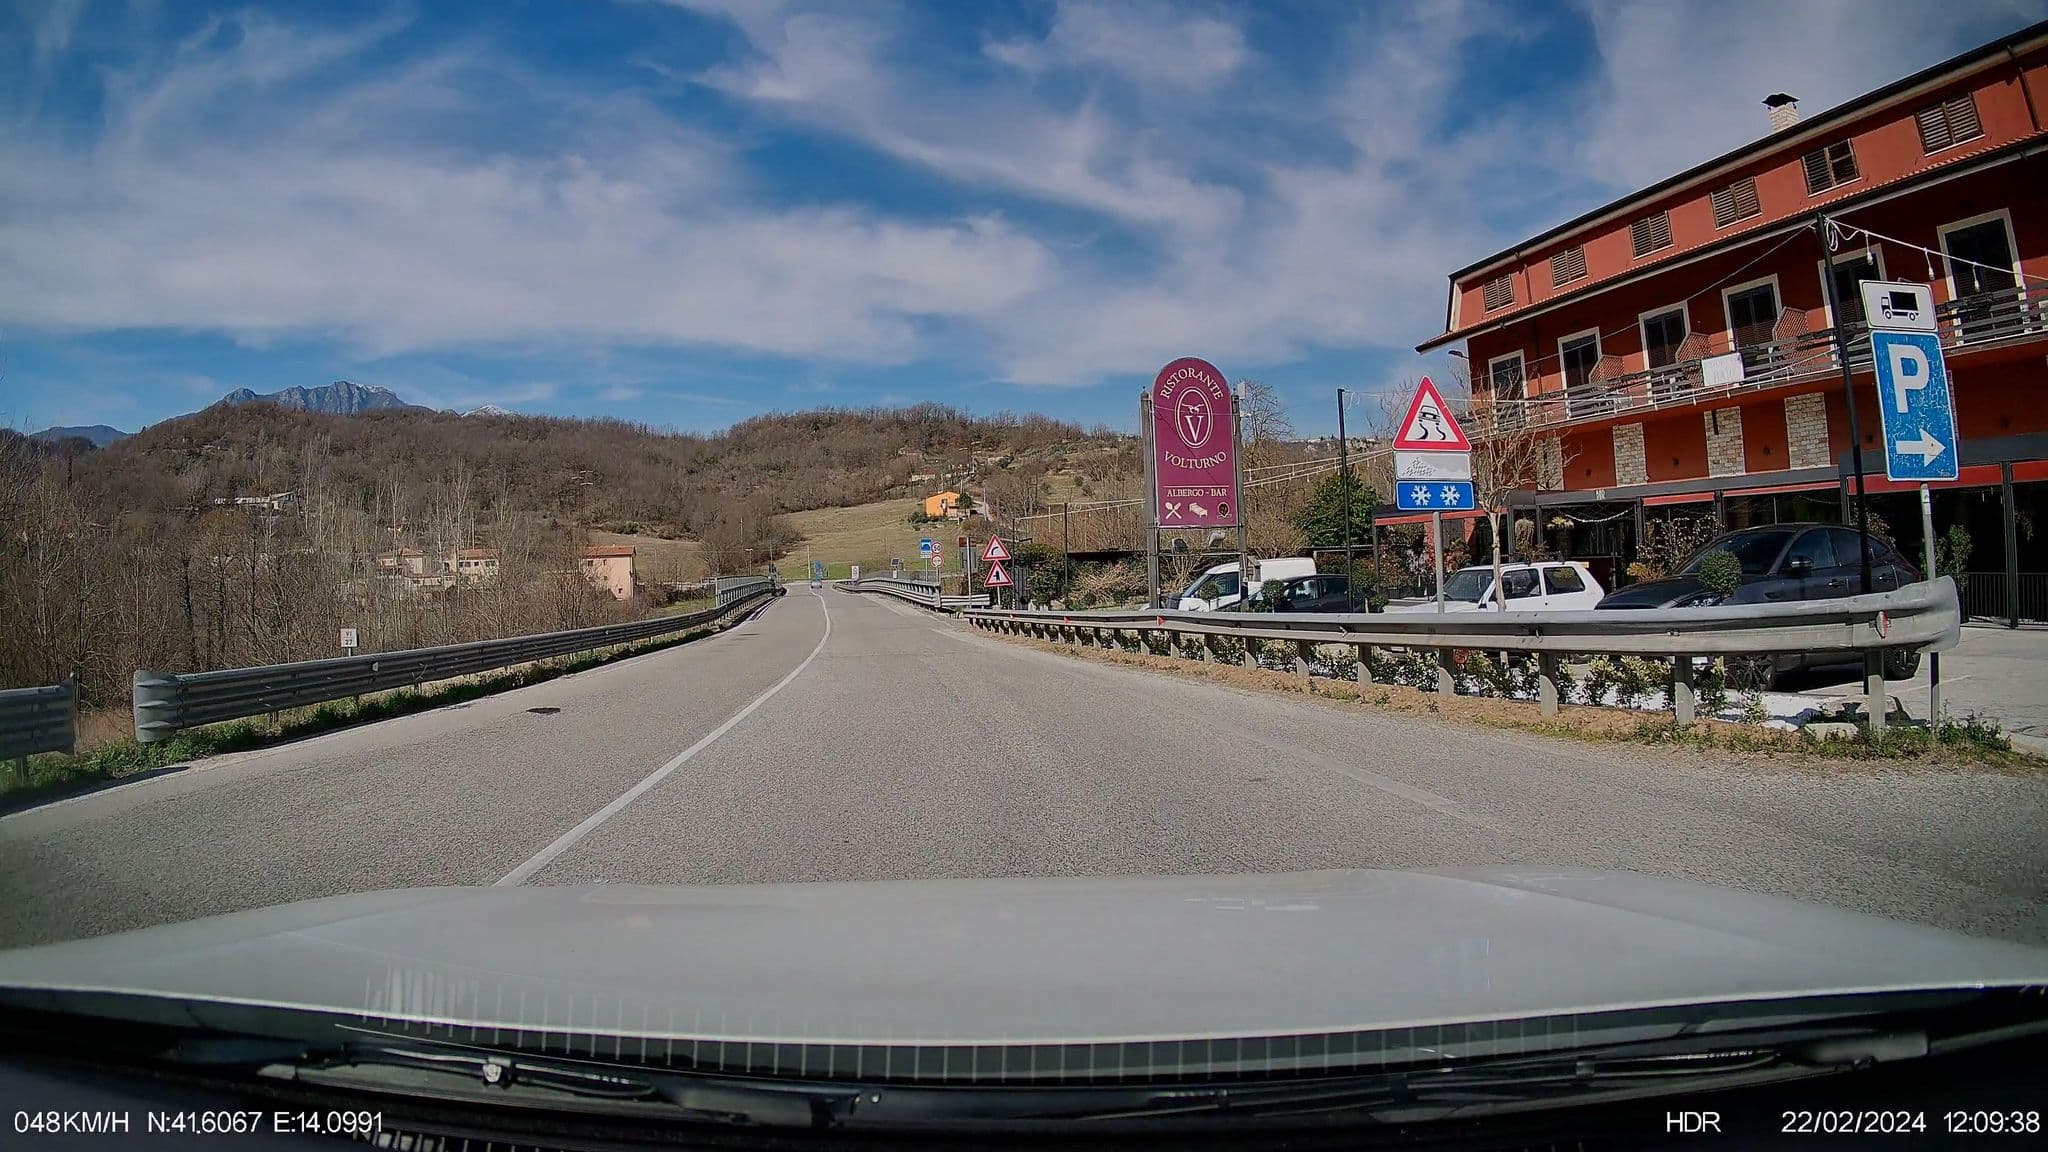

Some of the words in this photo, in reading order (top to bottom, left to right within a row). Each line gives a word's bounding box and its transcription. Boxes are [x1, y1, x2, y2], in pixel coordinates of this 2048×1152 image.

[1160, 367, 1223, 400] RISTORANTE
[1888, 344, 1930, 414] P
[1164, 451, 1227, 469] VOLTURNO
[1167, 488, 1204, 497] ALBERGO
[1211, 488, 1227, 497] BAR
